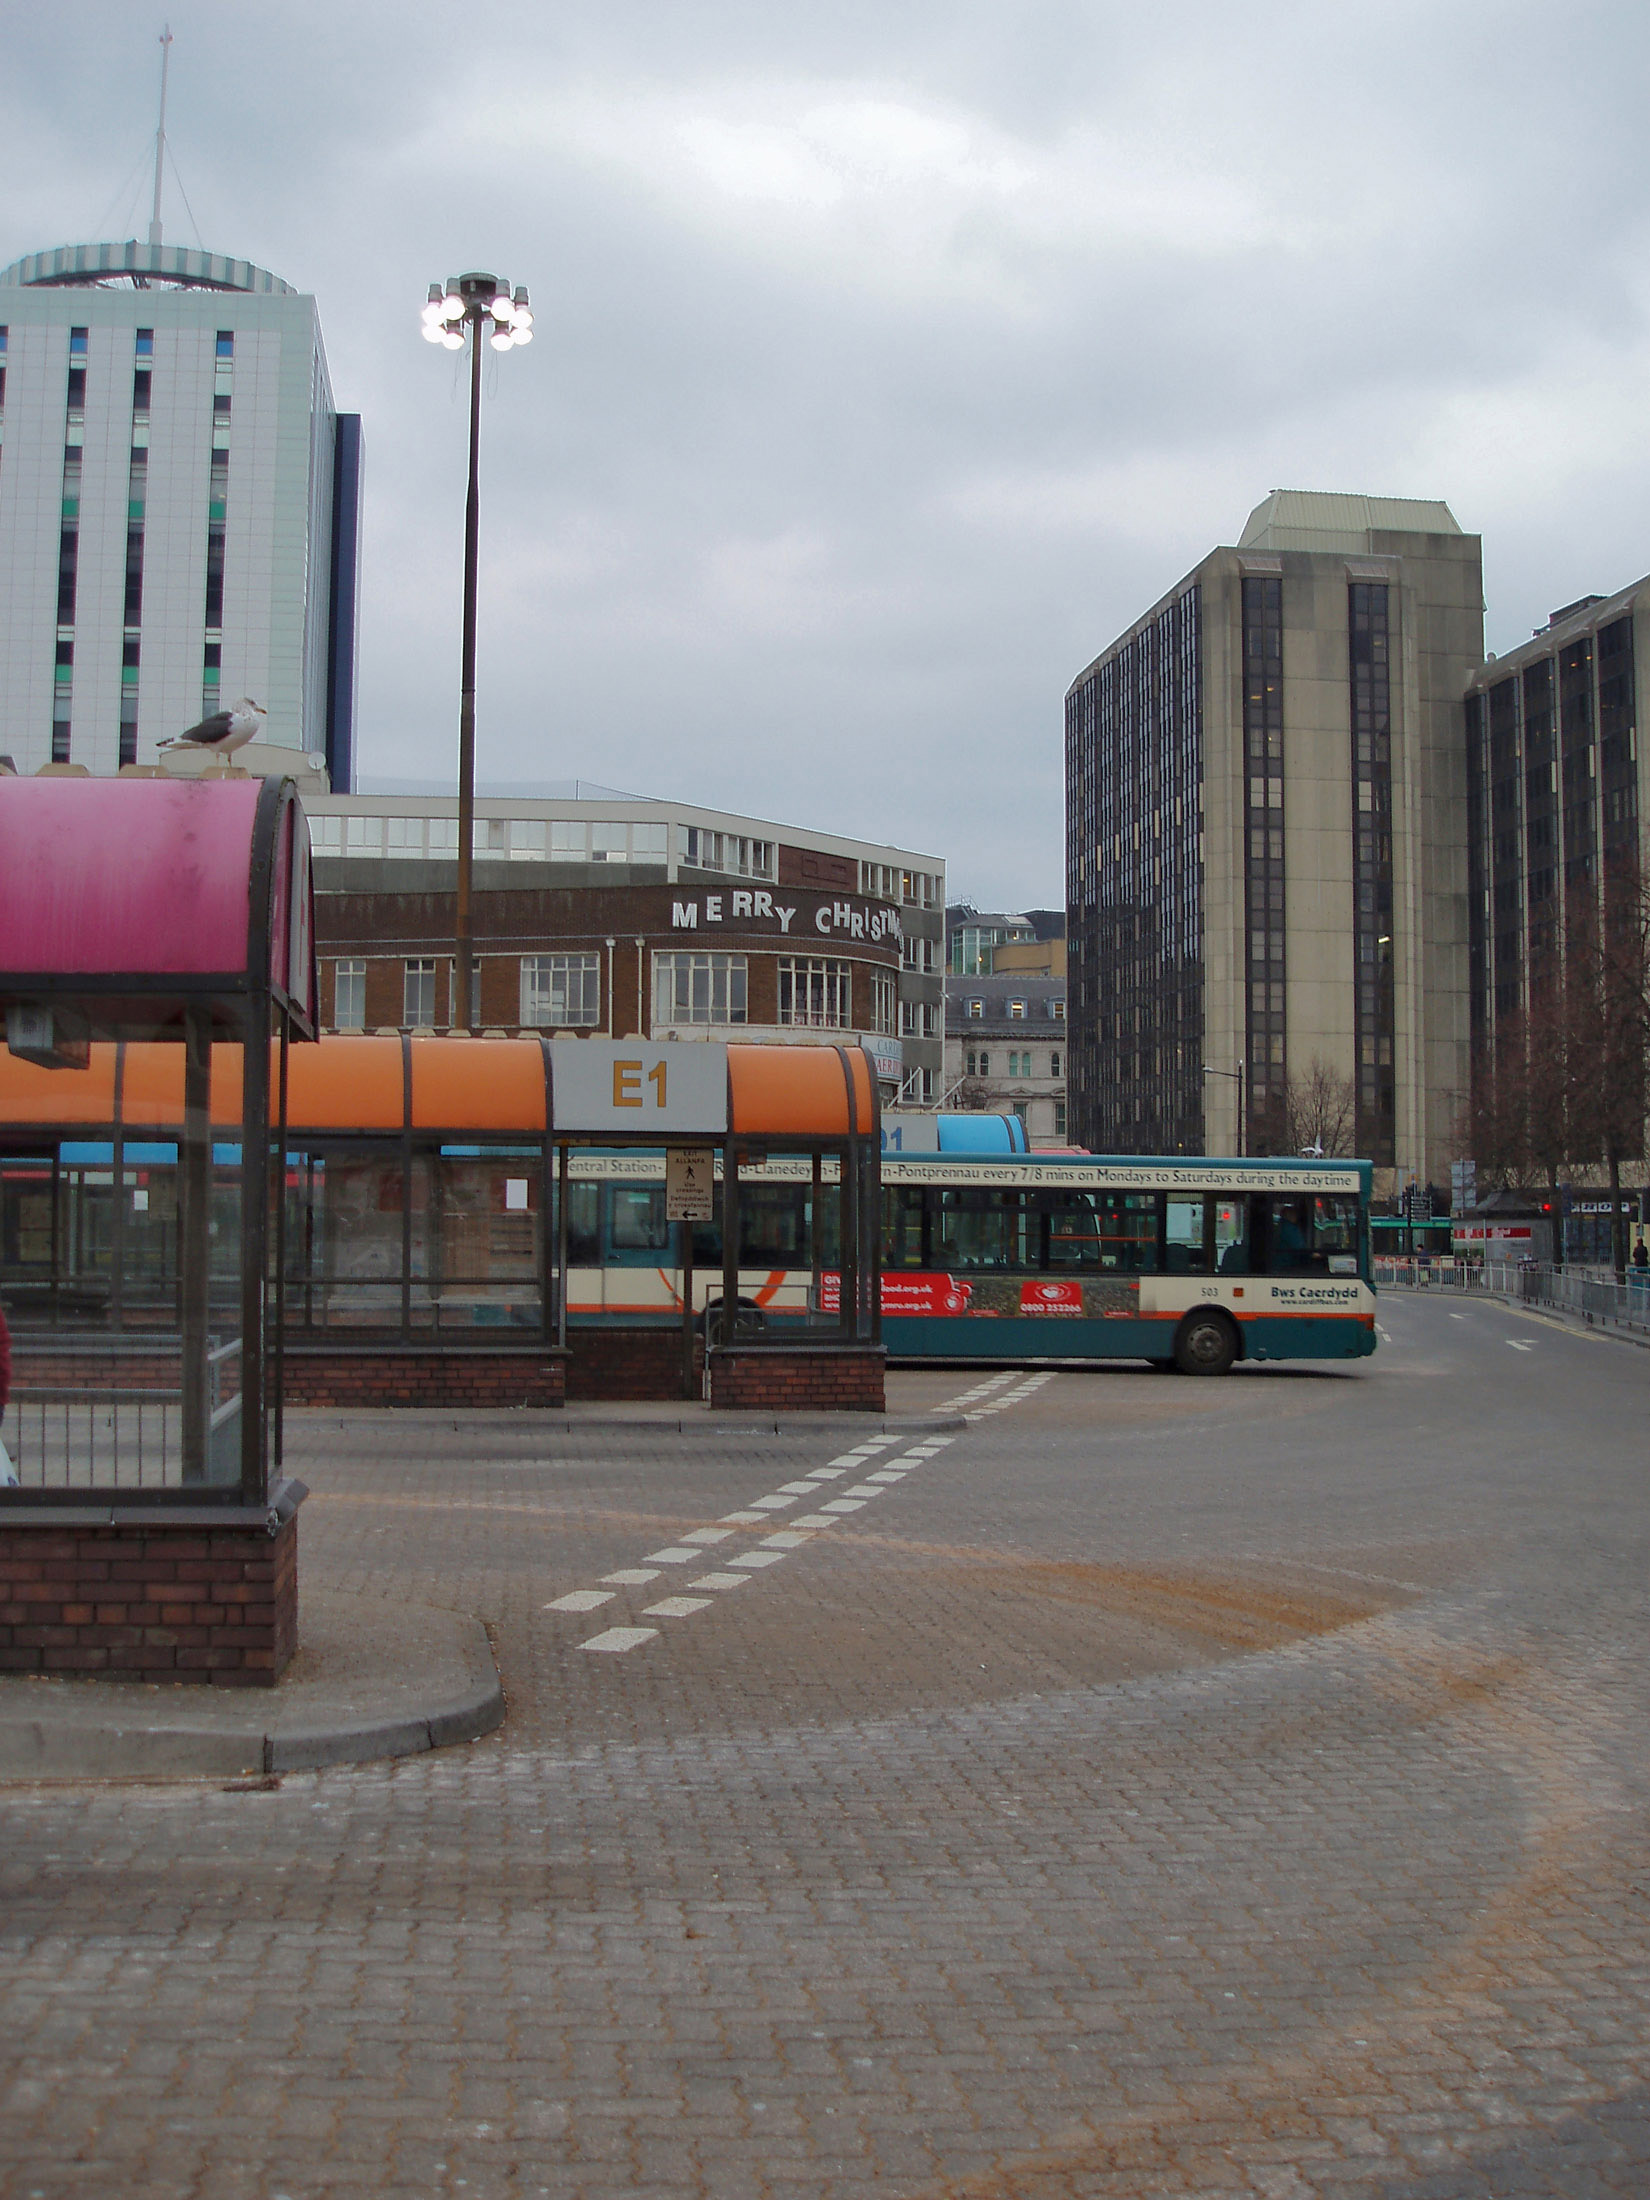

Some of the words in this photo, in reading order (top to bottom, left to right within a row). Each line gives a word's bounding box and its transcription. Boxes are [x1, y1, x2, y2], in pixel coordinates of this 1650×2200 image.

[672, 890, 796, 933] MERRY
[612, 1060, 667, 1108] E1
[558, 1159, 608, 1173] entral
[983, 1168, 1018, 1182] every
[1020, 1166, 1042, 1181] 7/8
[1046, 1168, 1074, 1182] mins
[1078, 1172, 1093, 1182] on
[1097, 1169, 1152, 1185] Mondays
[1156, 1172, 1169, 1182] to
[1173, 1170, 1232, 1186] Saturdays
[1236, 1172, 1275, 1187] during
[1279, 1173, 1299, 1185] the
[1303, 1173, 1352, 1188] daytime
[1201, 1287, 1218, 1297] 503
[1271, 1287, 1295, 1297] Bws
[1299, 1287, 1358, 1300] Caerdydd
[1020, 1303, 1045, 1312] 0800
